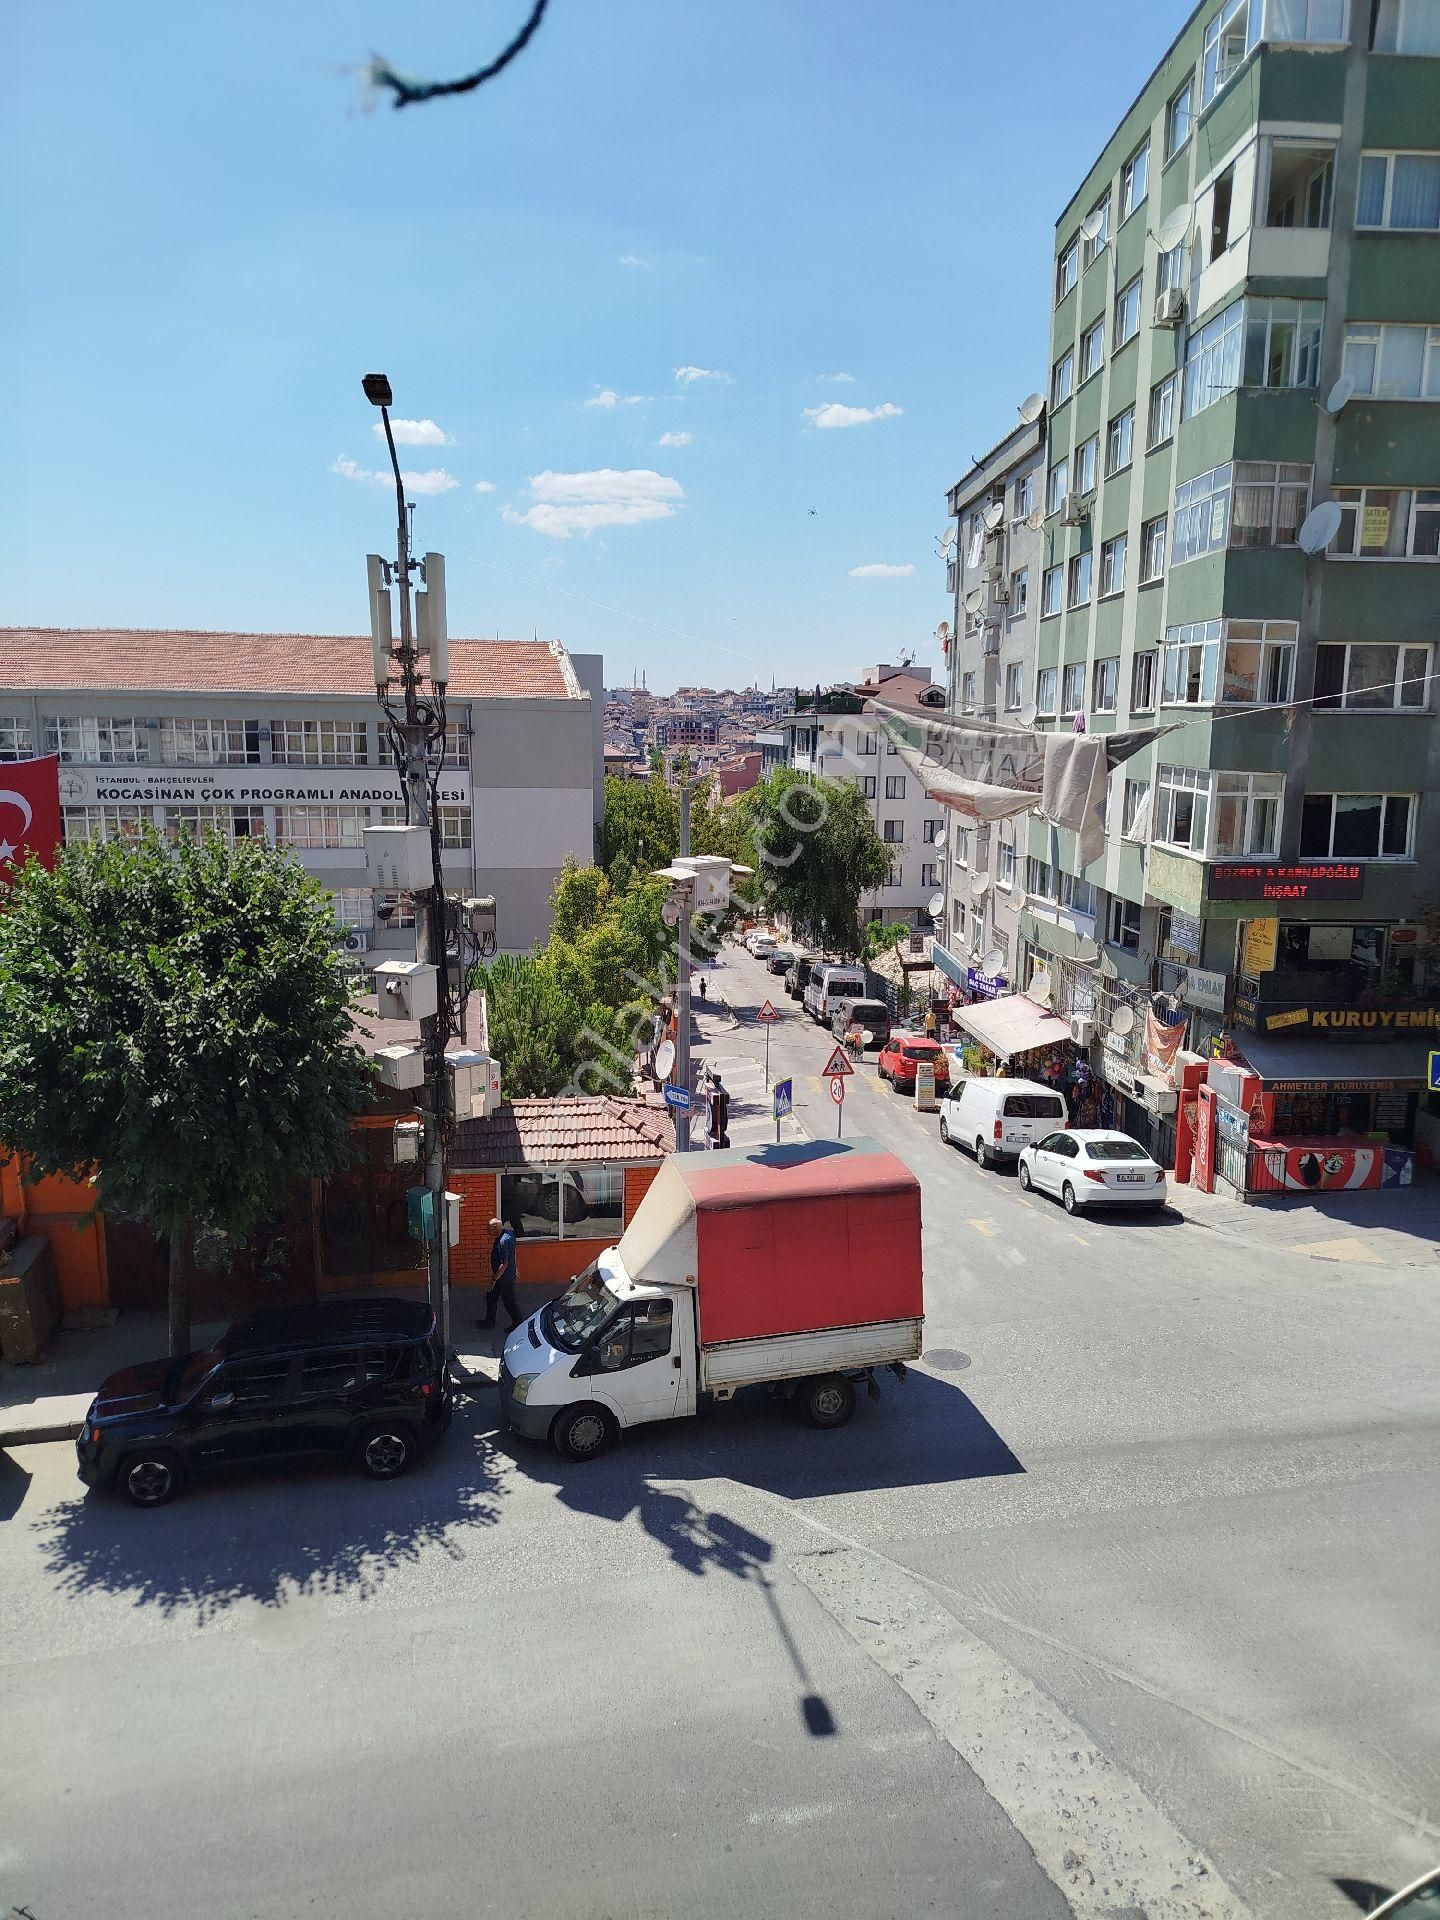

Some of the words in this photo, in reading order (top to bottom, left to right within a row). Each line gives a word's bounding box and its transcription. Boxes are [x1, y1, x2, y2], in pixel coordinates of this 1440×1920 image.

[96, 776, 140, 784] İSTANBUL
[147, 776, 215, 785] BAHÇELİEVLER
[96, 786, 195, 800] KOCASİNAN
[201, 788, 236, 802] ÇOK
[240, 789, 334, 800] PROGRAMLI
[339, 789, 404, 801] ANADOL
[426, 788, 465, 801] İSESİ
[1263, 884, 1308, 898] İNŞAAT
[1197, 977, 1224, 998] EMLAK
[833, 1081, 842, 1098] 20
[1272, 1082, 1328, 1091] AHMETLER
